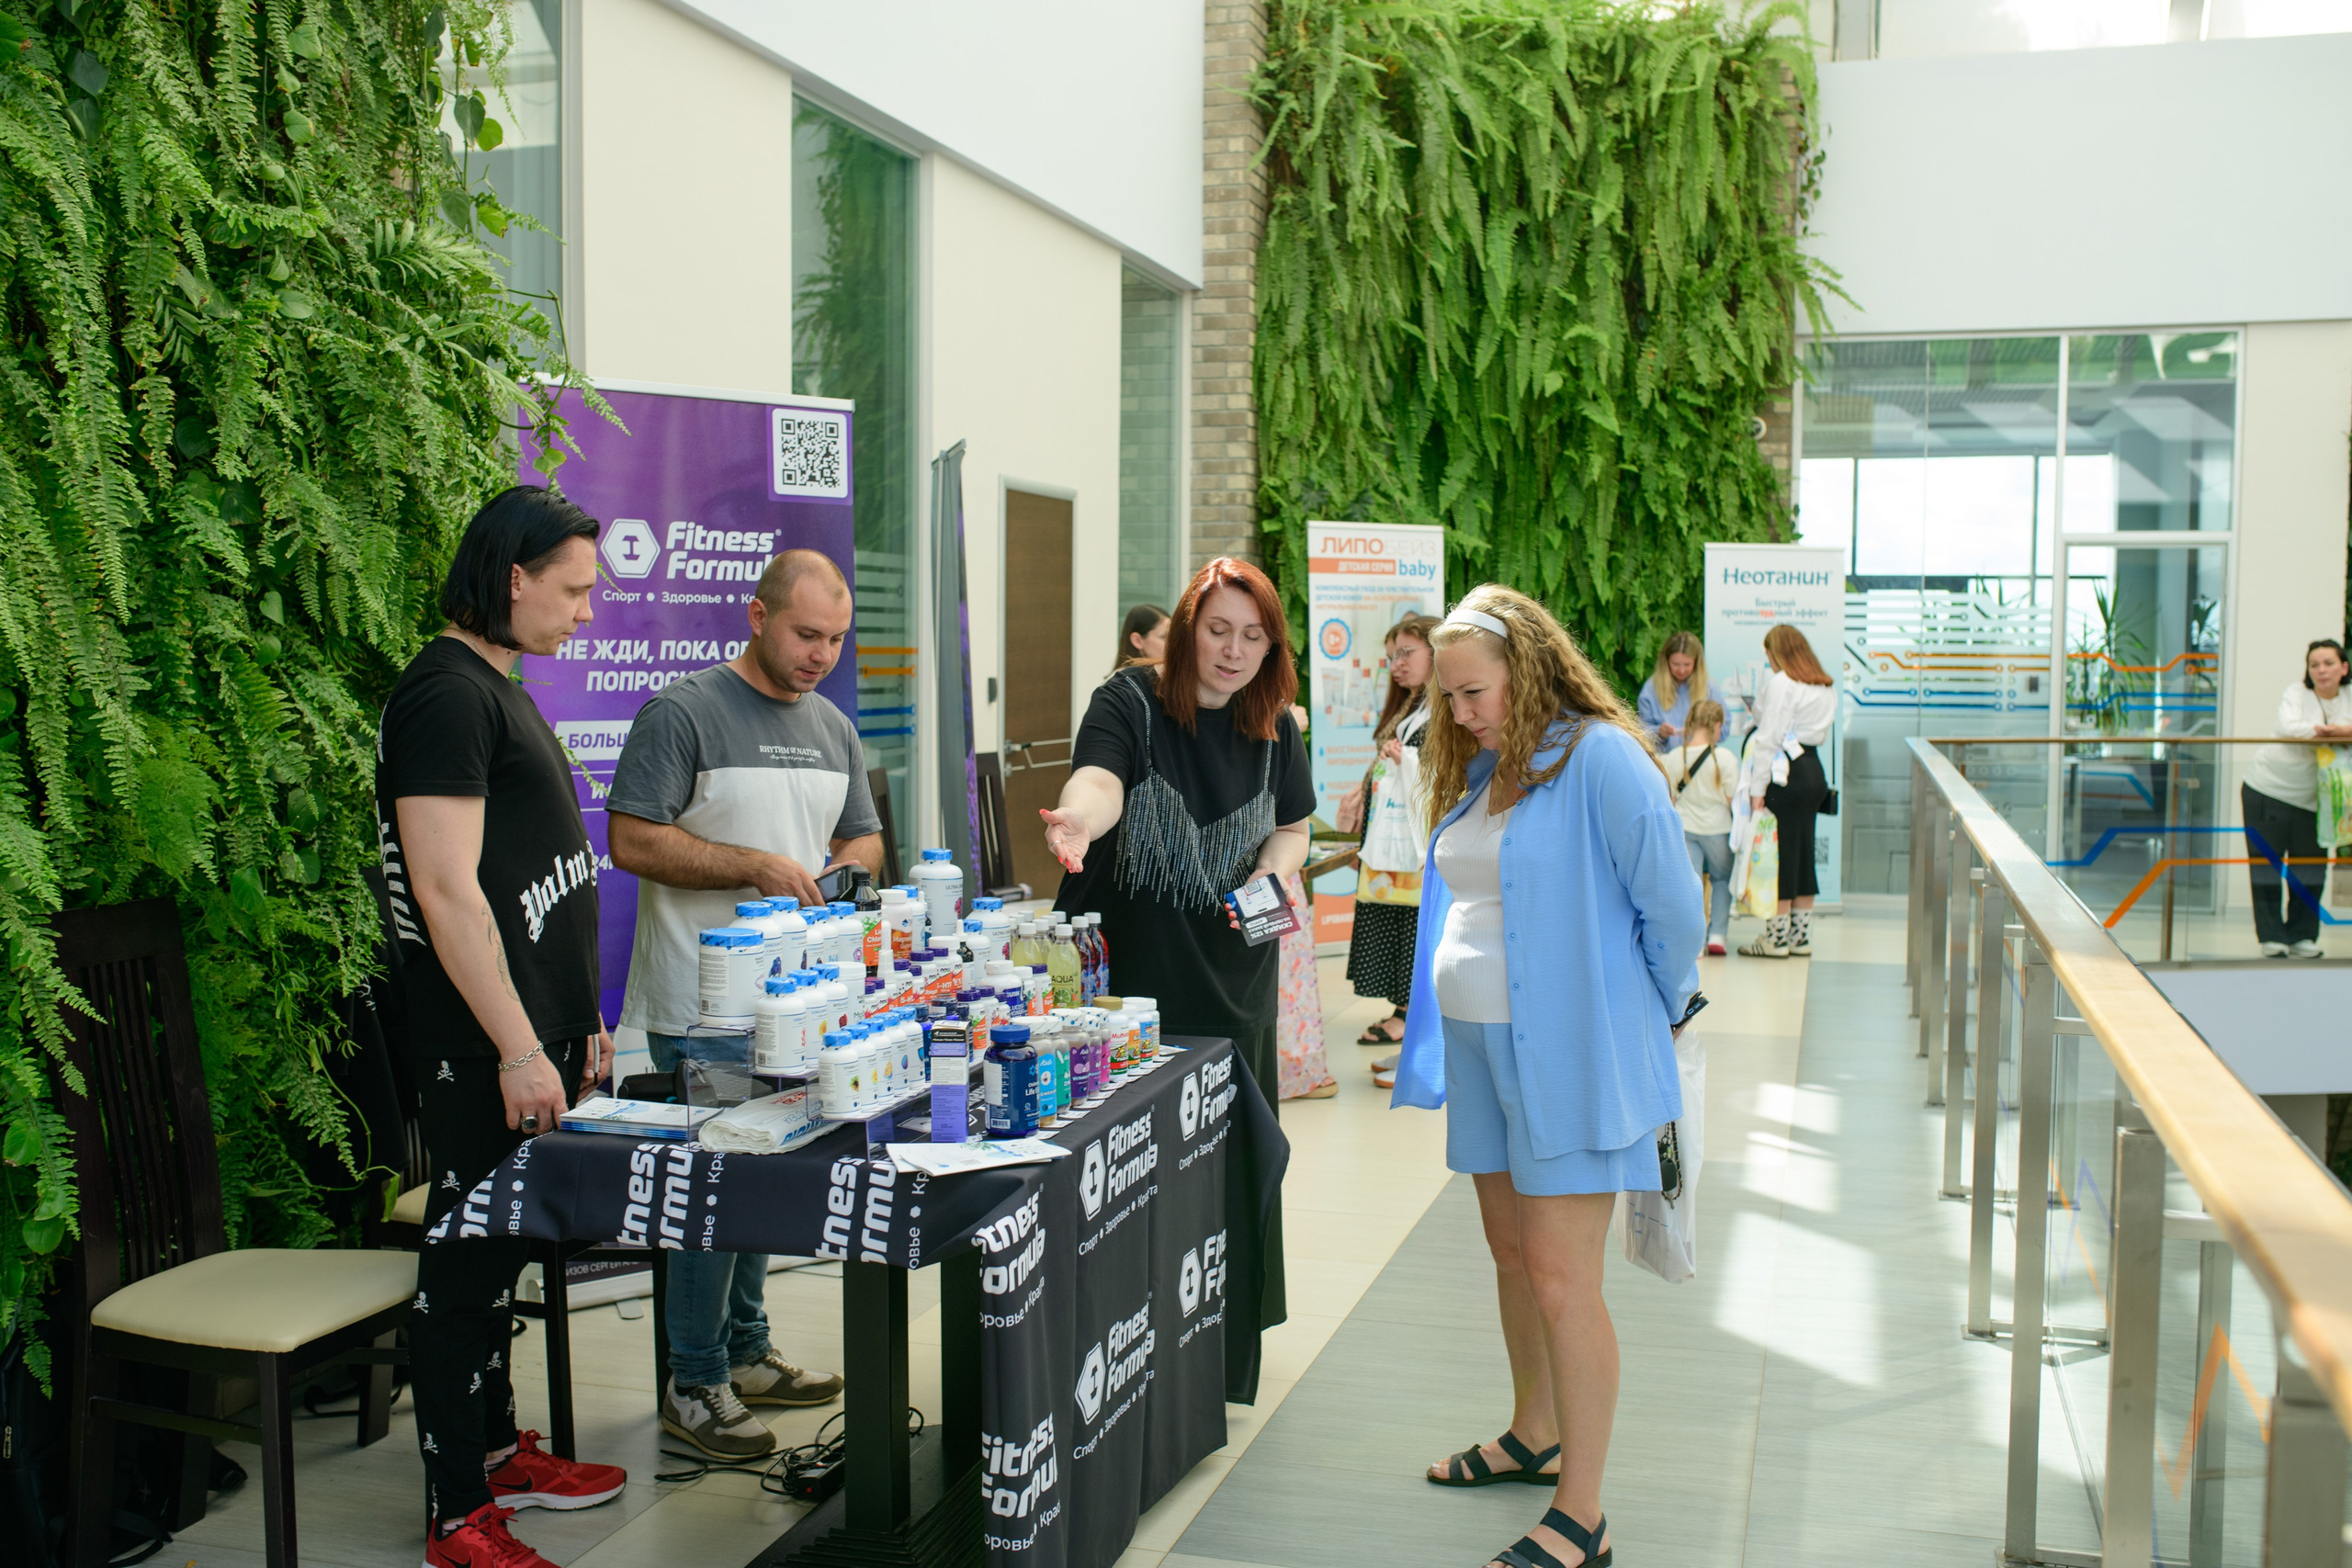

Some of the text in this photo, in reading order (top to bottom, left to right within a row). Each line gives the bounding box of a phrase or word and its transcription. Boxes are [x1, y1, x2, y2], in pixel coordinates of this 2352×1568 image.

[666, 521, 775, 552] Fitness
[1339, 561, 1394, 572] ДЕТСКАЯ СЕРИЯ
[1398, 559, 1436, 580] baby
[1724, 567, 1829, 586] Неотанин
[603, 590, 641, 604] Спорт
[662, 592, 721, 605] Здоровье
[1756, 598, 1795, 609] Быстрый
[1795, 609, 1828, 618] эффект
[556, 639, 589, 660] НЕ
[592, 639, 654, 664] ЖДИ,
[660, 640, 720, 660] ПОКА
[759, 745, 789, 754] RHYTHM
[797, 748, 822, 758] NATURE
[1264, 921, 1293, 934] СКИДКА
[1106, 1111, 1151, 1166] Fitness
[1107, 1138, 1158, 1203] Formula
[1079, 1234, 1099, 1256] Спорт
[1105, 1206, 1130, 1235] Здоровье
[1073, 1435, 1098, 1460] Спорт
[1104, 1398, 1131, 1433] Здоровье
